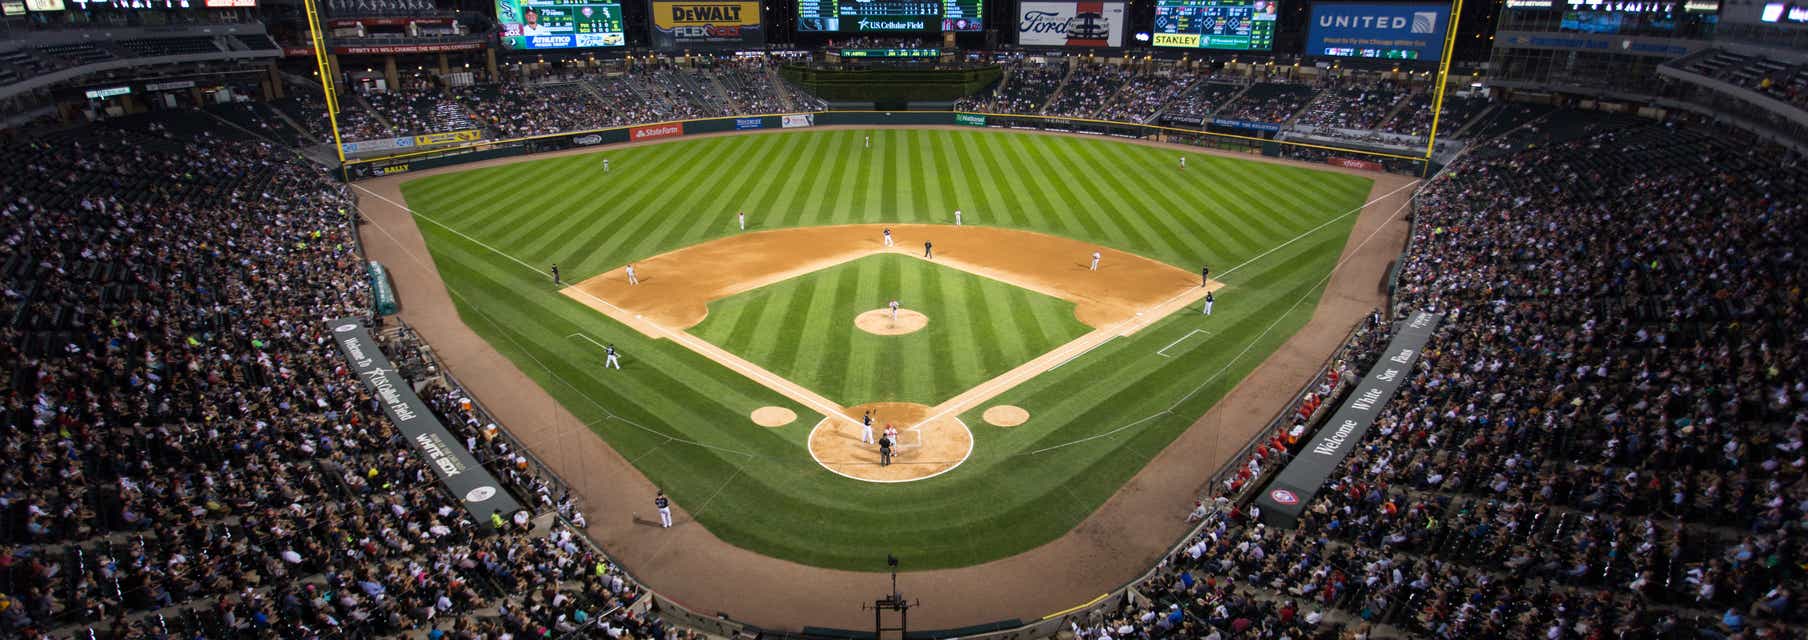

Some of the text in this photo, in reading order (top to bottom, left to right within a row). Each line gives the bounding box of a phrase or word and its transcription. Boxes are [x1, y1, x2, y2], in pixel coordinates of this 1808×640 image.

[672, 6, 741, 21] DEWALT
[881, 21, 906, 29] Cellular
[907, 21, 924, 29] Field
[1019, 11, 1073, 34] Ford
[1320, 15, 1407, 29] UNITED
[1155, 35, 1197, 44] STANLEY
[962, 114, 984, 122] National
[646, 126, 678, 137] State Farm
[343, 337, 365, 360] Welcome
[392, 402, 417, 422] Field
[1313, 418, 1358, 456] Welcome
[1352, 387, 1383, 411] White
[1376, 368, 1399, 382] Sox
[416, 433, 444, 460] WHITE
[435, 456, 461, 477] SOX
